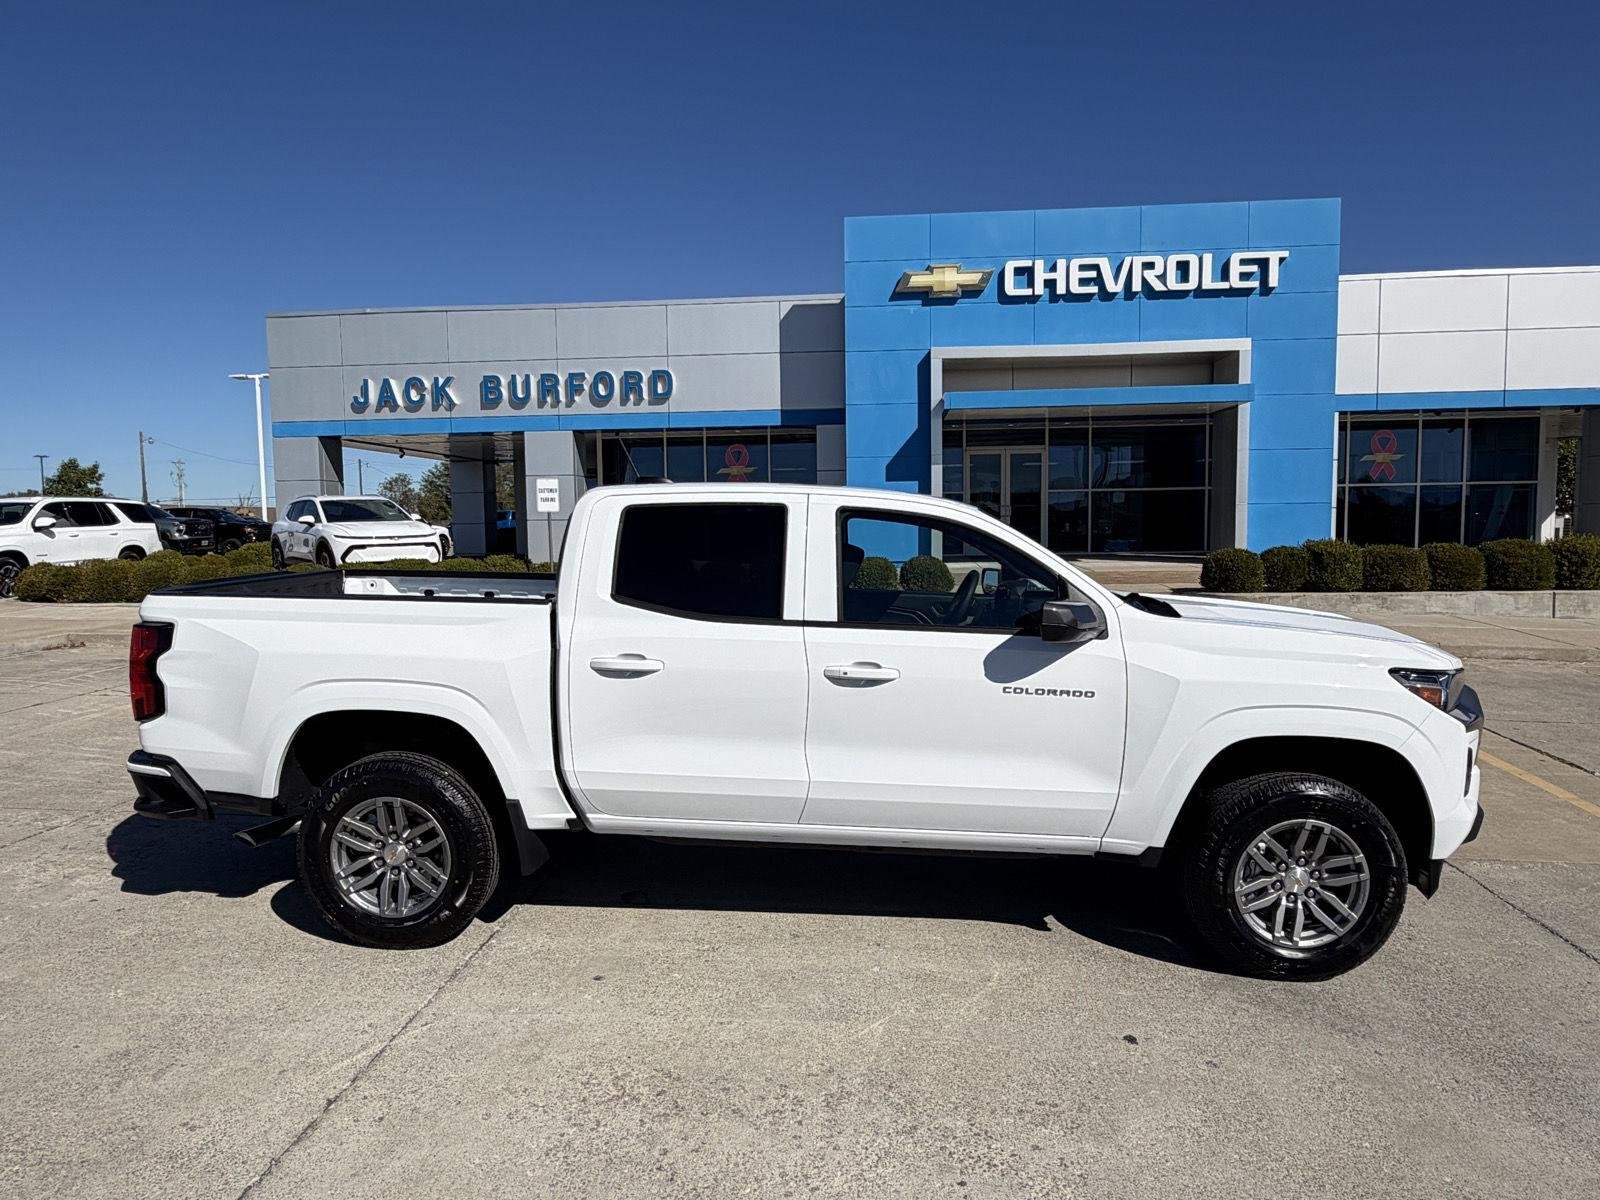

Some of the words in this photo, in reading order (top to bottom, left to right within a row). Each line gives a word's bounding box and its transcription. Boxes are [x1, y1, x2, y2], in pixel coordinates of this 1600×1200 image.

[1003, 251, 1290, 296] CHEVROLET
[352, 375, 457, 408] JACK
[481, 369, 674, 403] BURFORD
[1002, 686, 1095, 698] COLORADO
